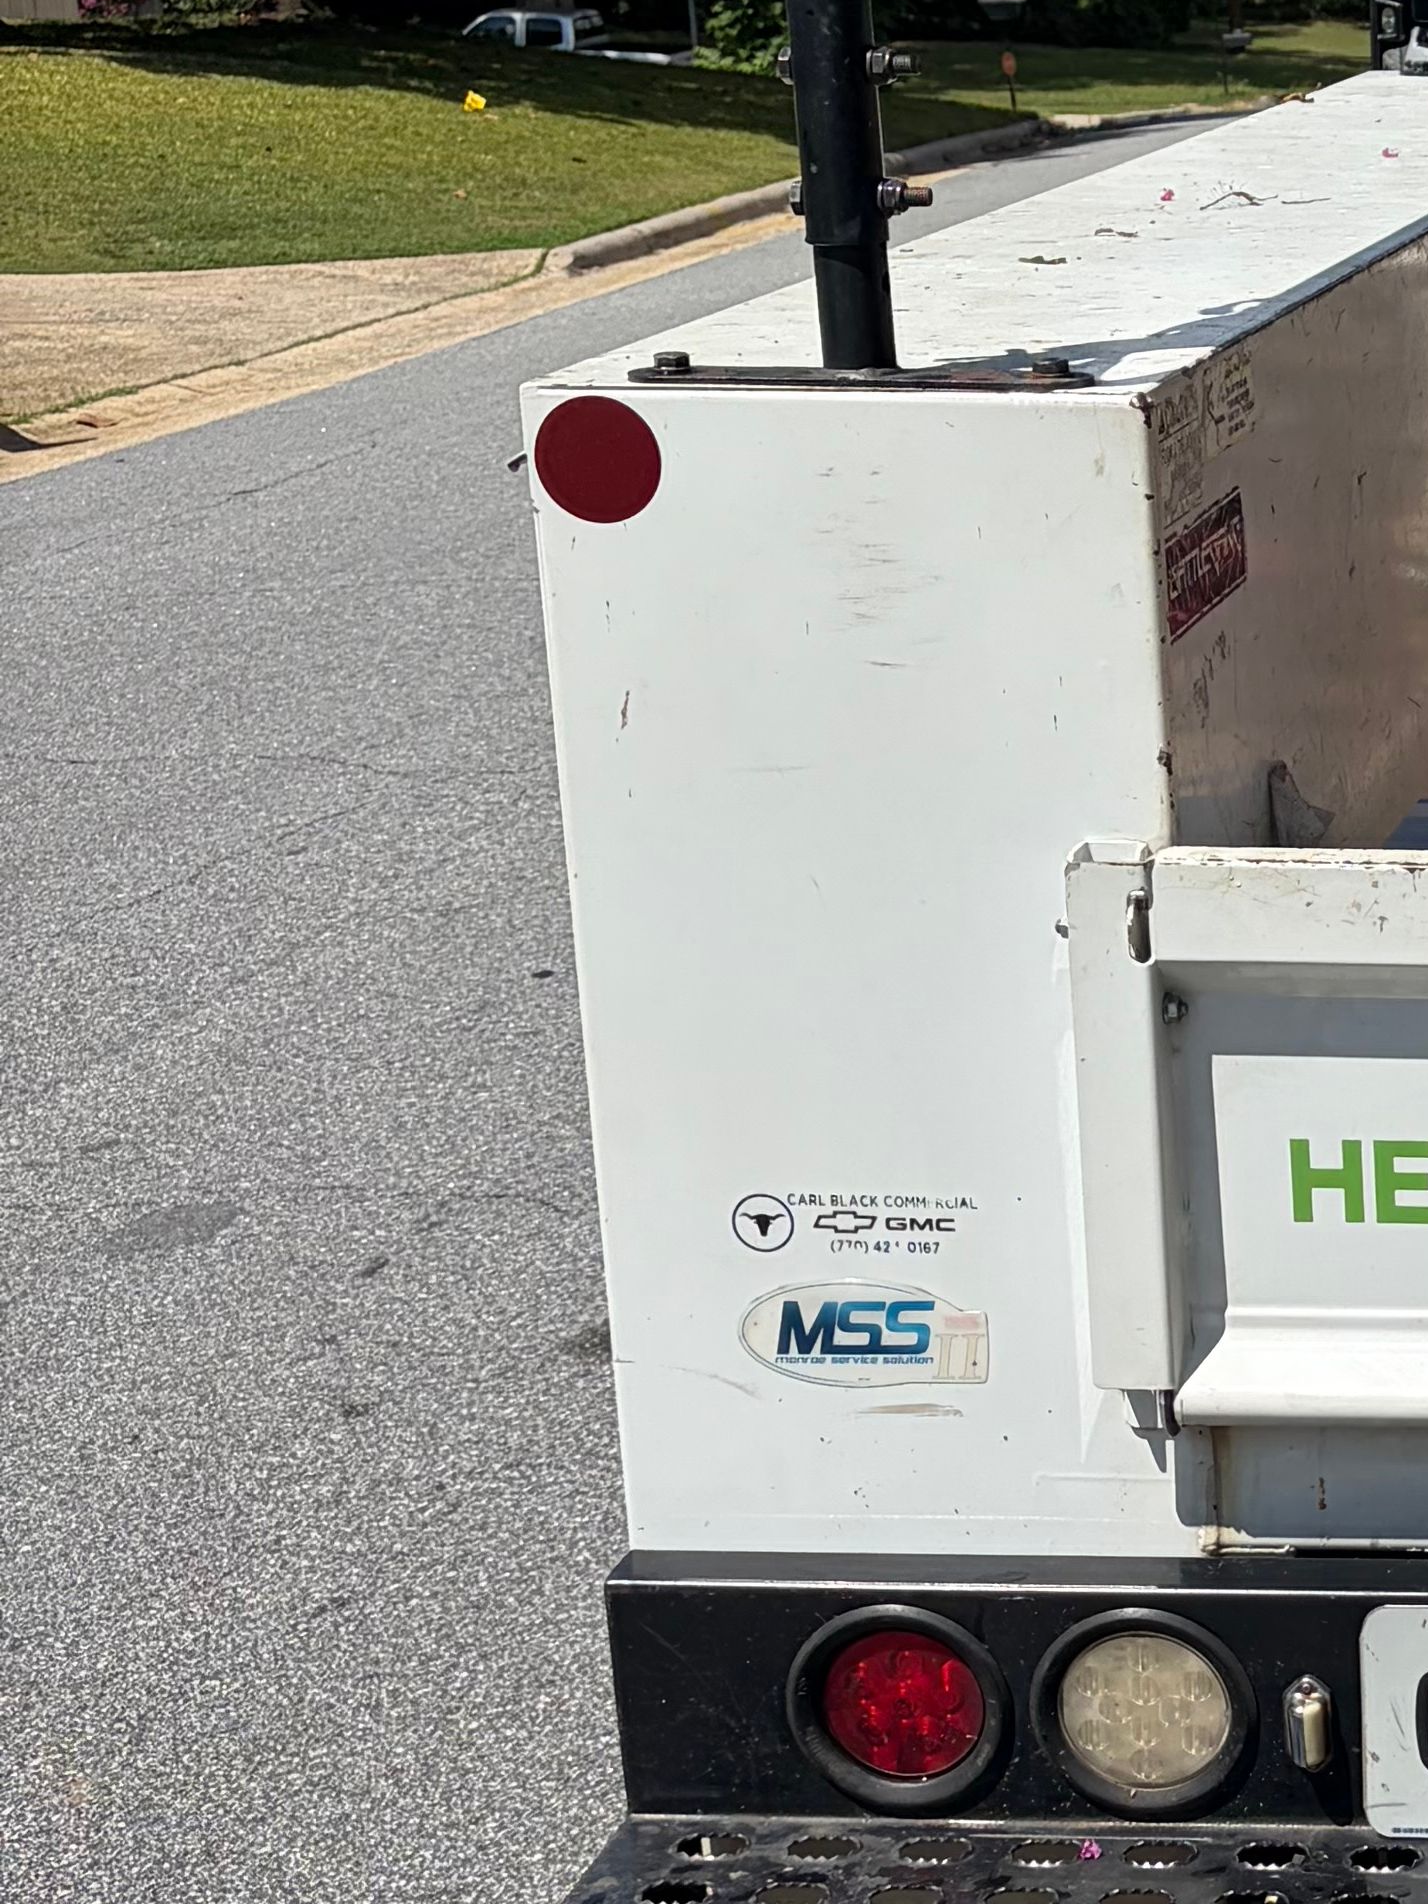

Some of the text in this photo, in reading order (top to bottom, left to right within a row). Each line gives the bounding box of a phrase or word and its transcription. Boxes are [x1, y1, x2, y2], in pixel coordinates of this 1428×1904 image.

[787, 1193, 826, 1207] CARL
[830, 1194, 879, 1208] BLACK
[885, 1217, 956, 1232] GMC
[777, 1301, 935, 1355] MSS
[775, 1355, 934, 1366] monroe service solution
